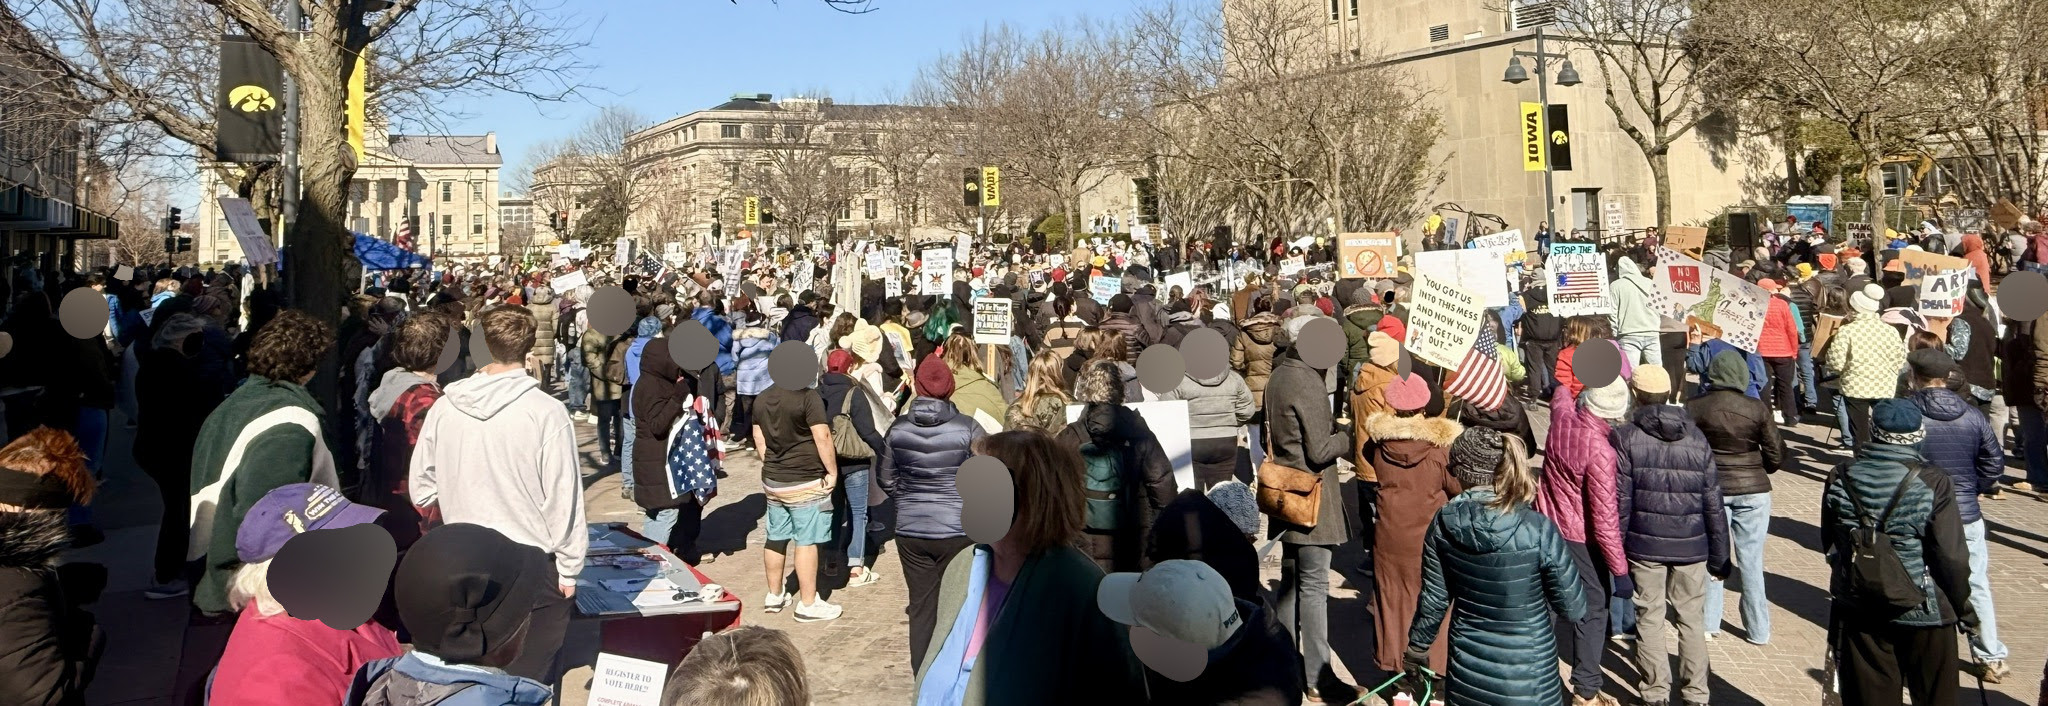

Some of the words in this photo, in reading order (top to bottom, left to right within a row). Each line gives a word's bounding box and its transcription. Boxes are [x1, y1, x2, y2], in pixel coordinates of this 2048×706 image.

[1526, 111, 1539, 163] IOWA
[986, 171, 996, 201] IOWA
[1554, 245, 1576, 256] STOP
[1578, 245, 1593, 254] THE
[1677, 267, 1691, 277] NO
[1671, 280, 1700, 293] KINGS
[1930, 270, 1967, 293] ART
[1442, 286, 1460, 299] GOT
[1460, 294, 1472, 304] US
[1553, 293, 1582, 304] RESIST
[1419, 289, 1437, 304] INTO
[1438, 298, 1456, 312] THIS
[1456, 306, 1478, 321] MESS
[1921, 299, 1951, 310] DEAL
[1416, 303, 1433, 317] AND
[1434, 311, 1455, 327] NOW
[1456, 320, 1474, 335] YOU
[1411, 315, 1434, 333] CAN'T
[1435, 327, 1452, 340] GET
[1453, 334, 1464, 345] US
[605, 668, 641, 681] REGISTER
[642, 674, 652, 683] TO
[605, 678, 623, 689] VOTE
